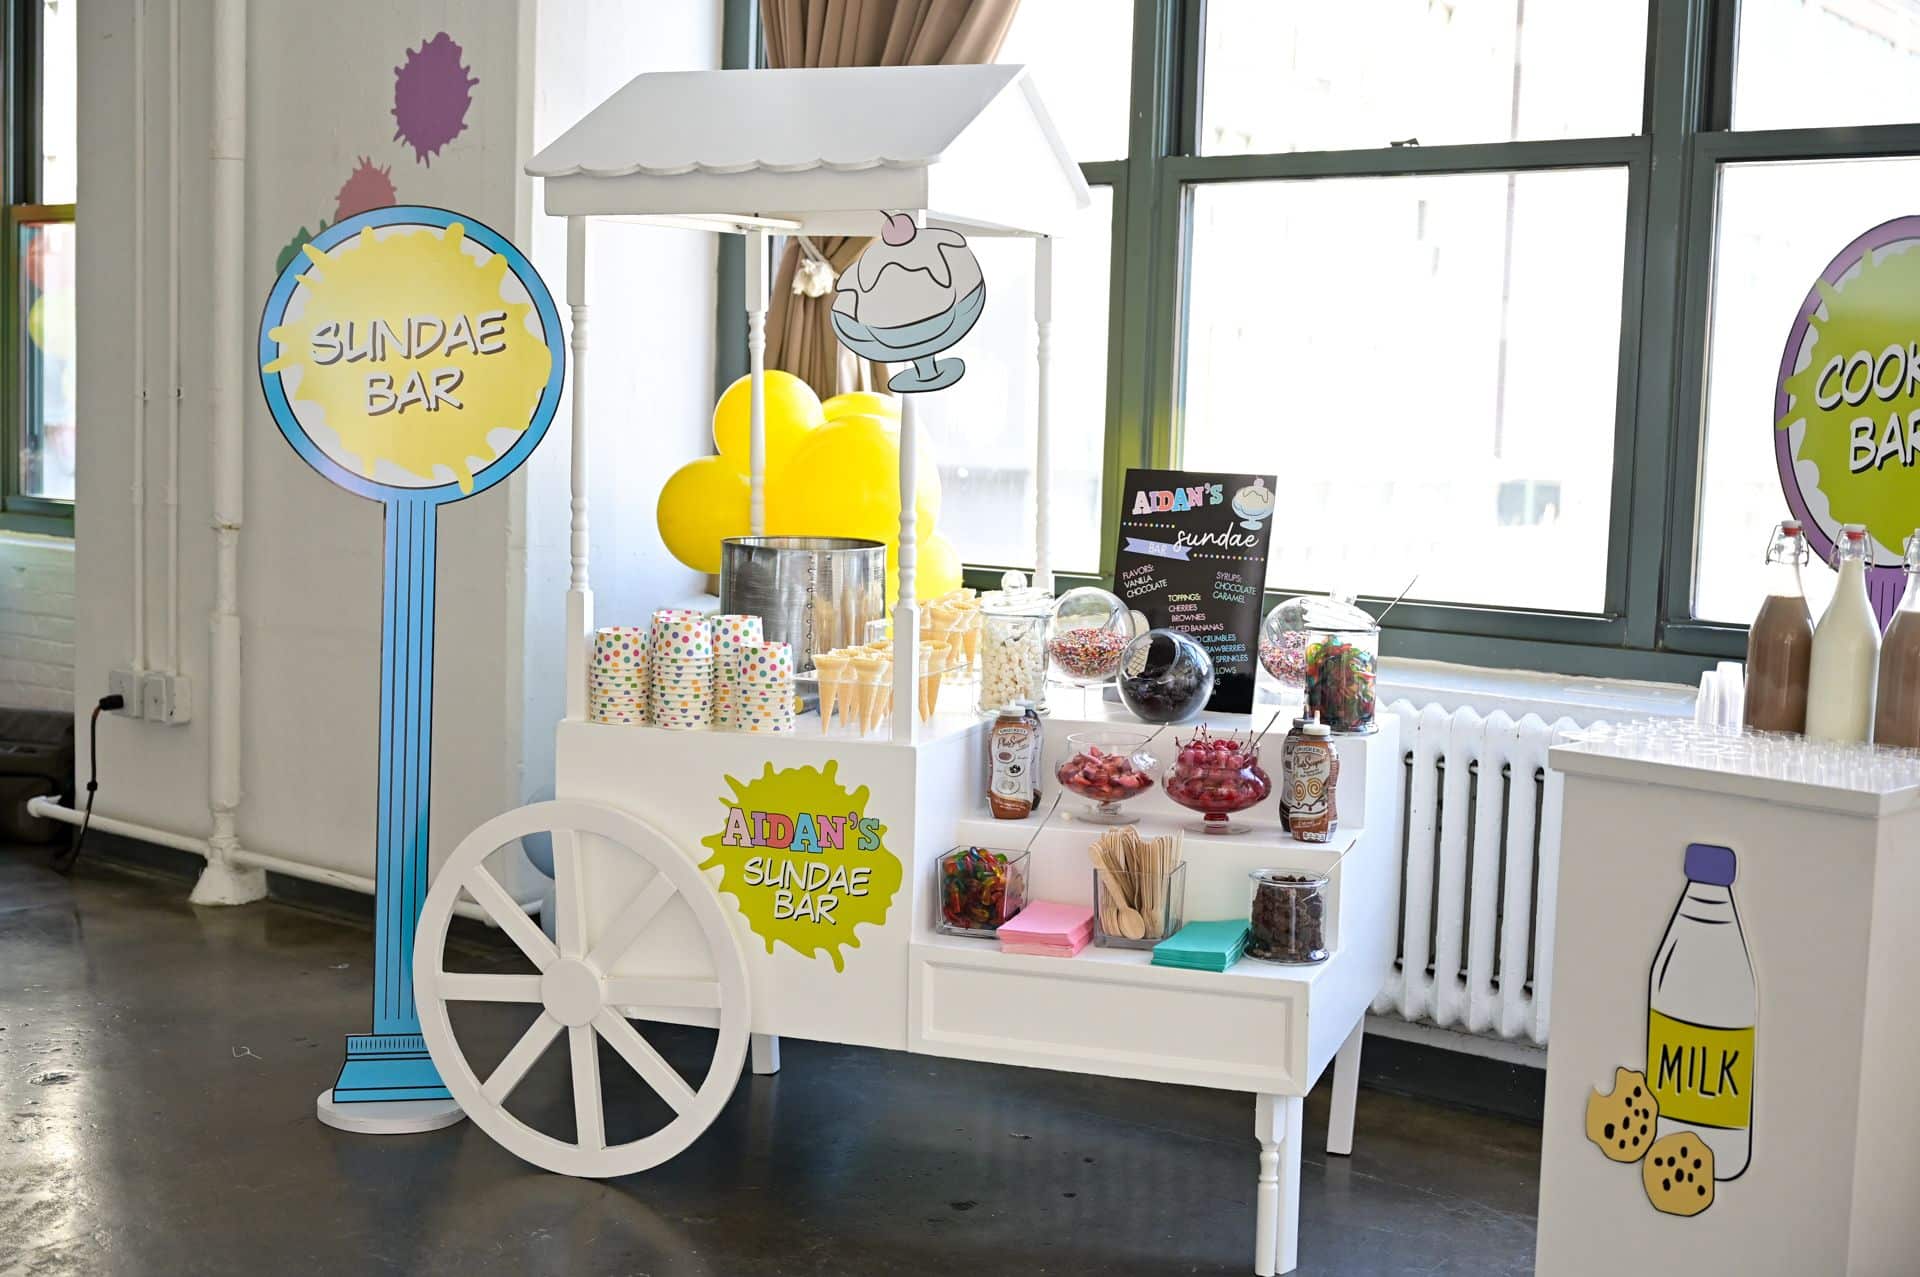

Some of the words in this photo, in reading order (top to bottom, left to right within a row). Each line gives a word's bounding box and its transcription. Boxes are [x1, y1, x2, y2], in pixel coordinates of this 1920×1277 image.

[309, 311, 508, 365] SUNDAE
[365, 367, 466, 416] BAR
[1132, 482, 1224, 515] AIDAN'S
[1173, 522, 1259, 552] sundae
[1147, 543, 1168, 554] BAR
[1122, 563, 1155, 581] FLAVORS:
[1216, 571, 1242, 583] SYRUPS:
[1123, 574, 1153, 589] VANILLA
[1126, 579, 1169, 599] CHOCOLATE
[1214, 582, 1257, 596] CHOCOLATE
[1167, 593, 1202, 602] TOPPINGS:
[1212, 591, 1246, 604] CARAMEL
[1168, 603, 1198, 612] CHERRIES
[1171, 613, 1206, 622] BROWNIES
[1190, 623, 1224, 632] BANANAS
[1202, 634, 1237, 643] CRUMBLES
[1215, 654, 1249, 663] SPRINKLES
[721, 807, 881, 854] AIDAN'S
[743, 856, 872, 897] SUNDAE
[773, 891, 839, 925] BAR
[1657, 1044, 1741, 1098] MILK
